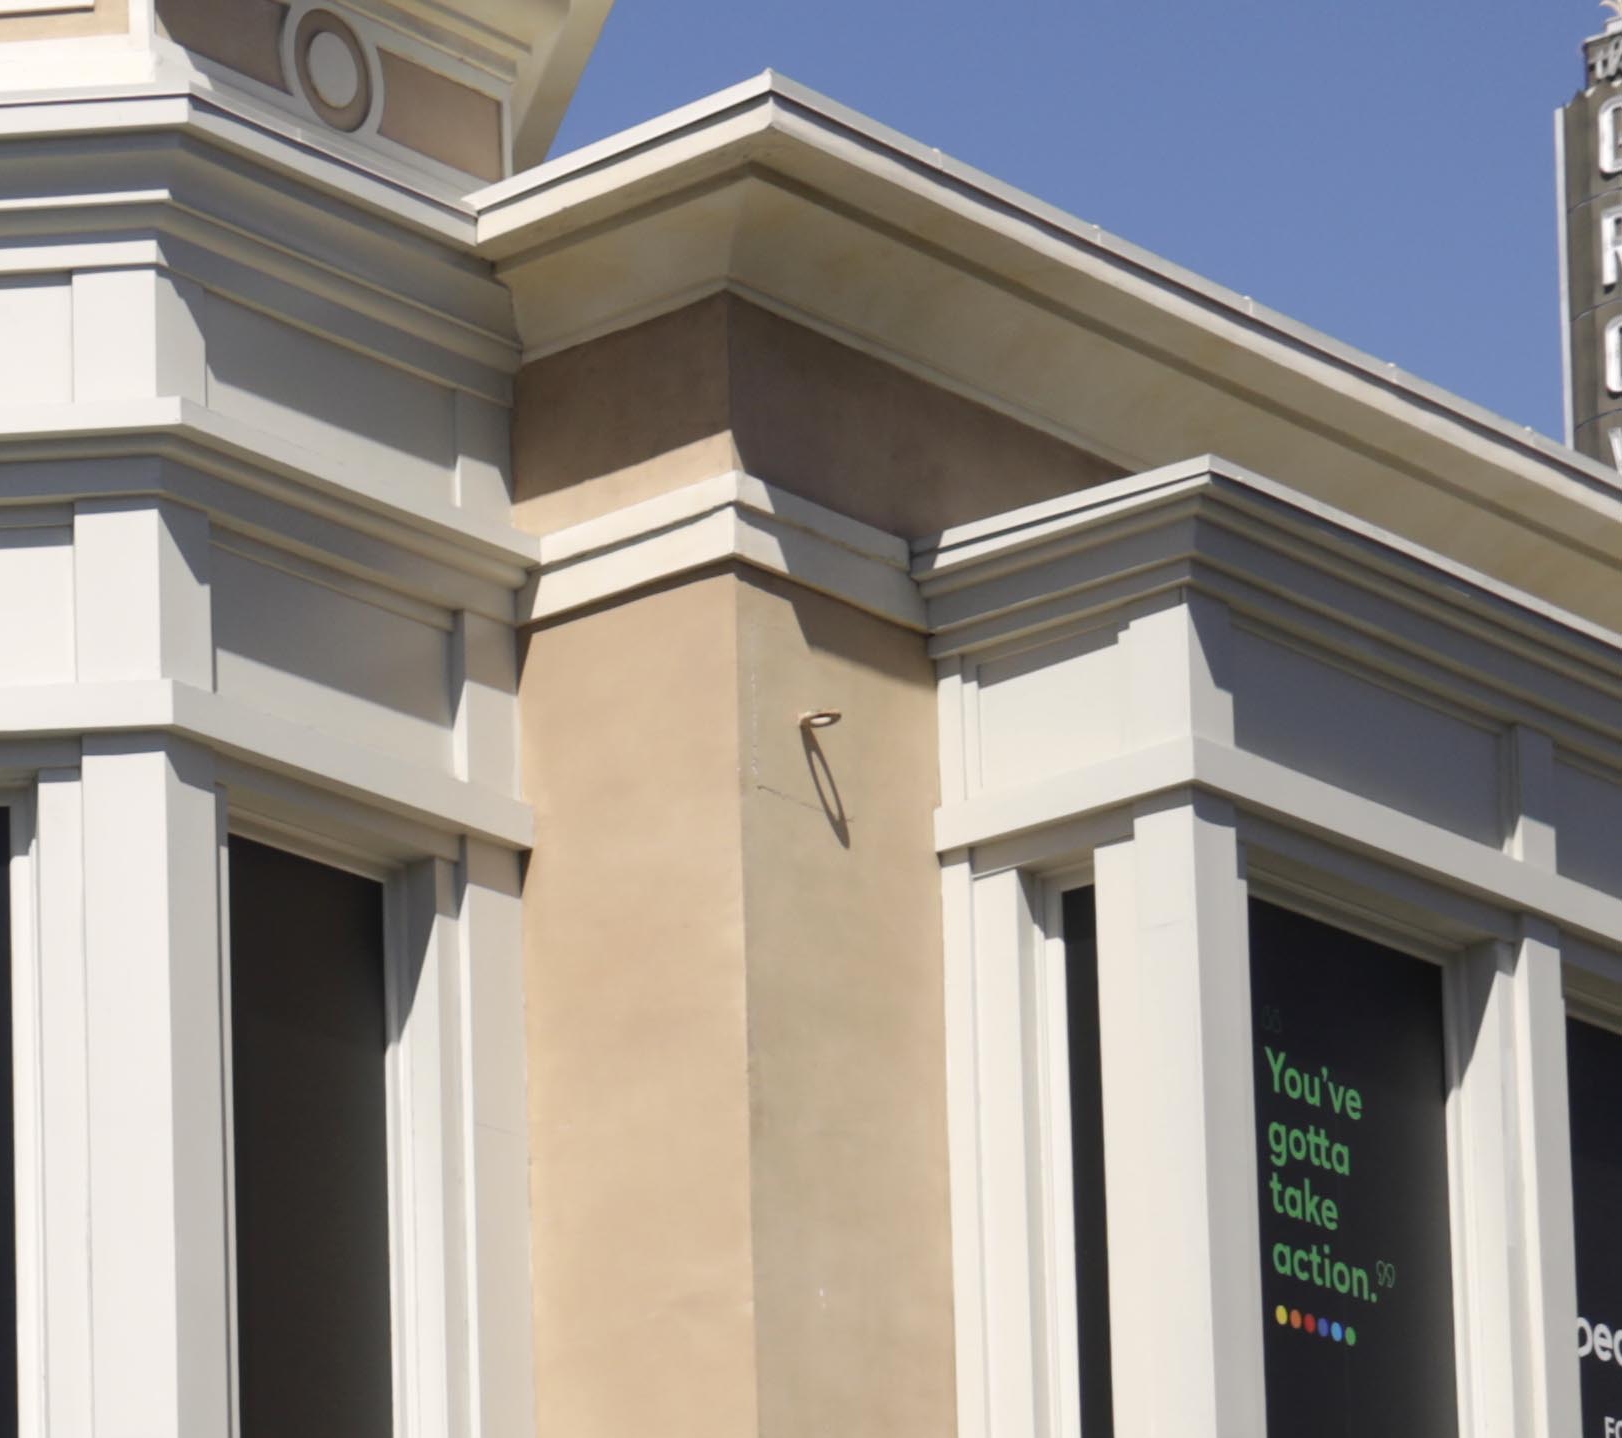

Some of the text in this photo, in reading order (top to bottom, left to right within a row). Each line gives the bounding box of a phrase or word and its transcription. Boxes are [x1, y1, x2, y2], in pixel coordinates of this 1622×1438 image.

[1266, 1046, 1363, 1122] You've
[1267, 1119, 1351, 1178] gotta
[1271, 1173, 1339, 1231] take
